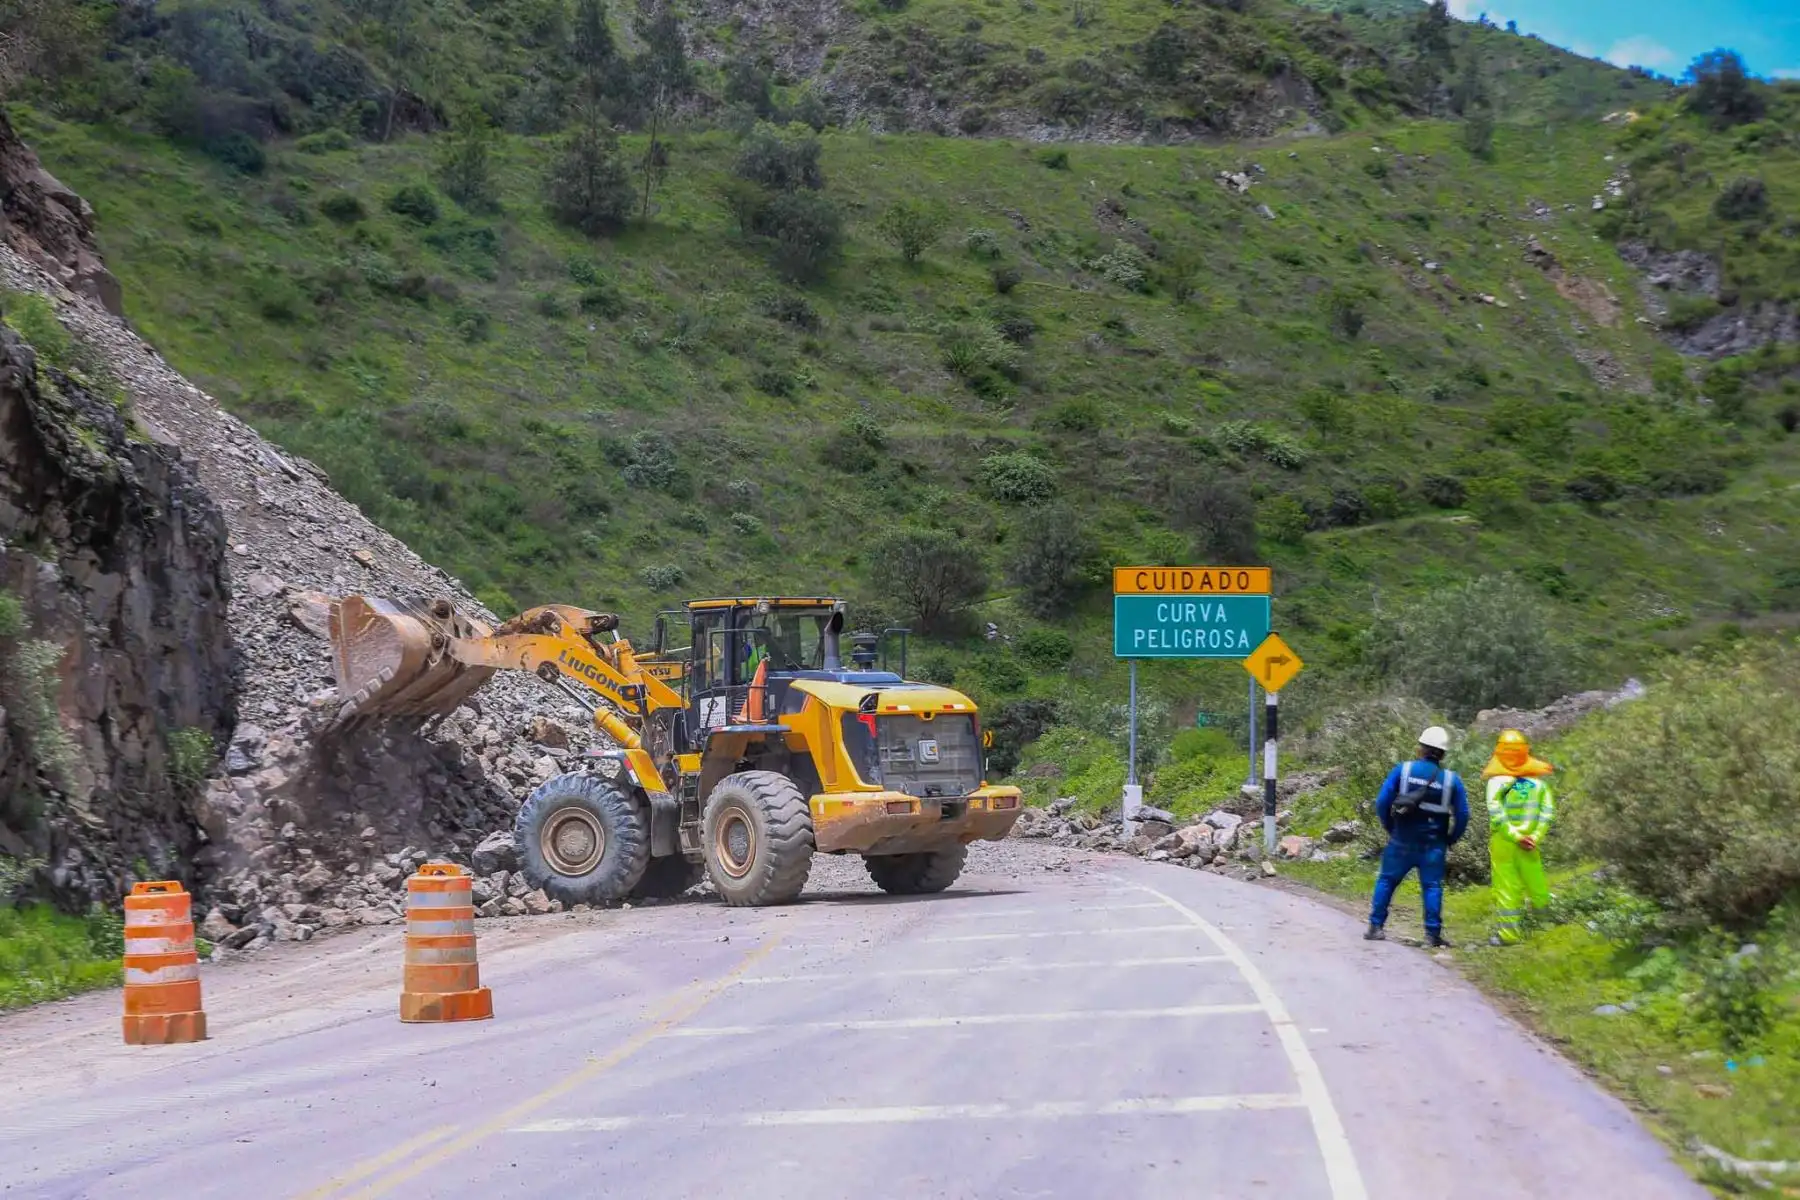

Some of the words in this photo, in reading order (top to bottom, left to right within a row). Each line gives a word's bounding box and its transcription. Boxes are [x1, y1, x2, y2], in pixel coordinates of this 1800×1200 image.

[1135, 571, 1250, 591] CUIDADO
[1156, 603, 1228, 623] CURVA
[1134, 629, 1250, 649] PELIGROSA
[558, 649, 624, 696] LIUGON
